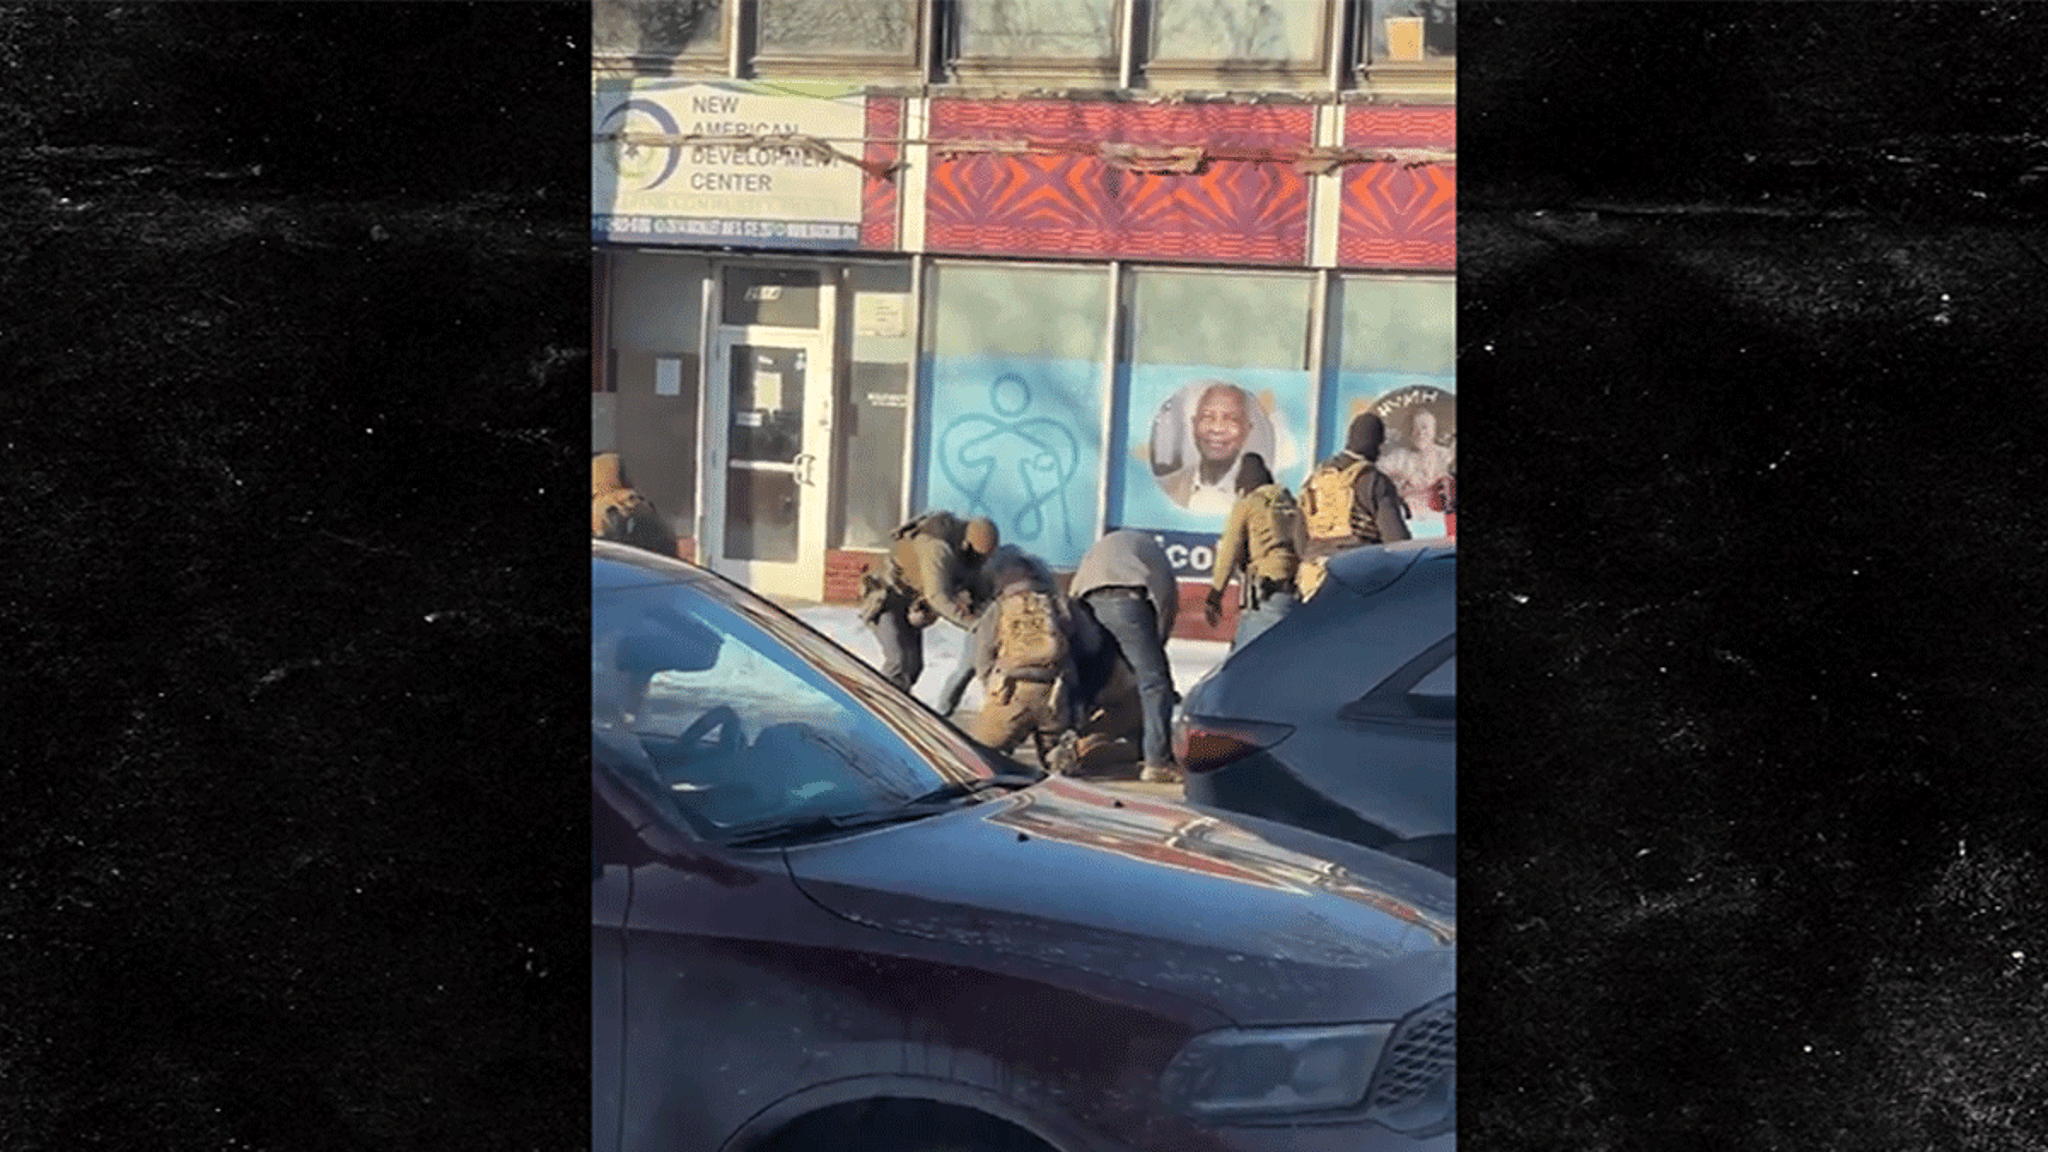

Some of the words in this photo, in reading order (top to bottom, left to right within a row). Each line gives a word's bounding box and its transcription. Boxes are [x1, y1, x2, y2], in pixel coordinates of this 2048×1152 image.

[692, 96, 739, 113] NEW
[692, 121, 799, 137] AMERICAN
[690, 172, 772, 191] CENTER
